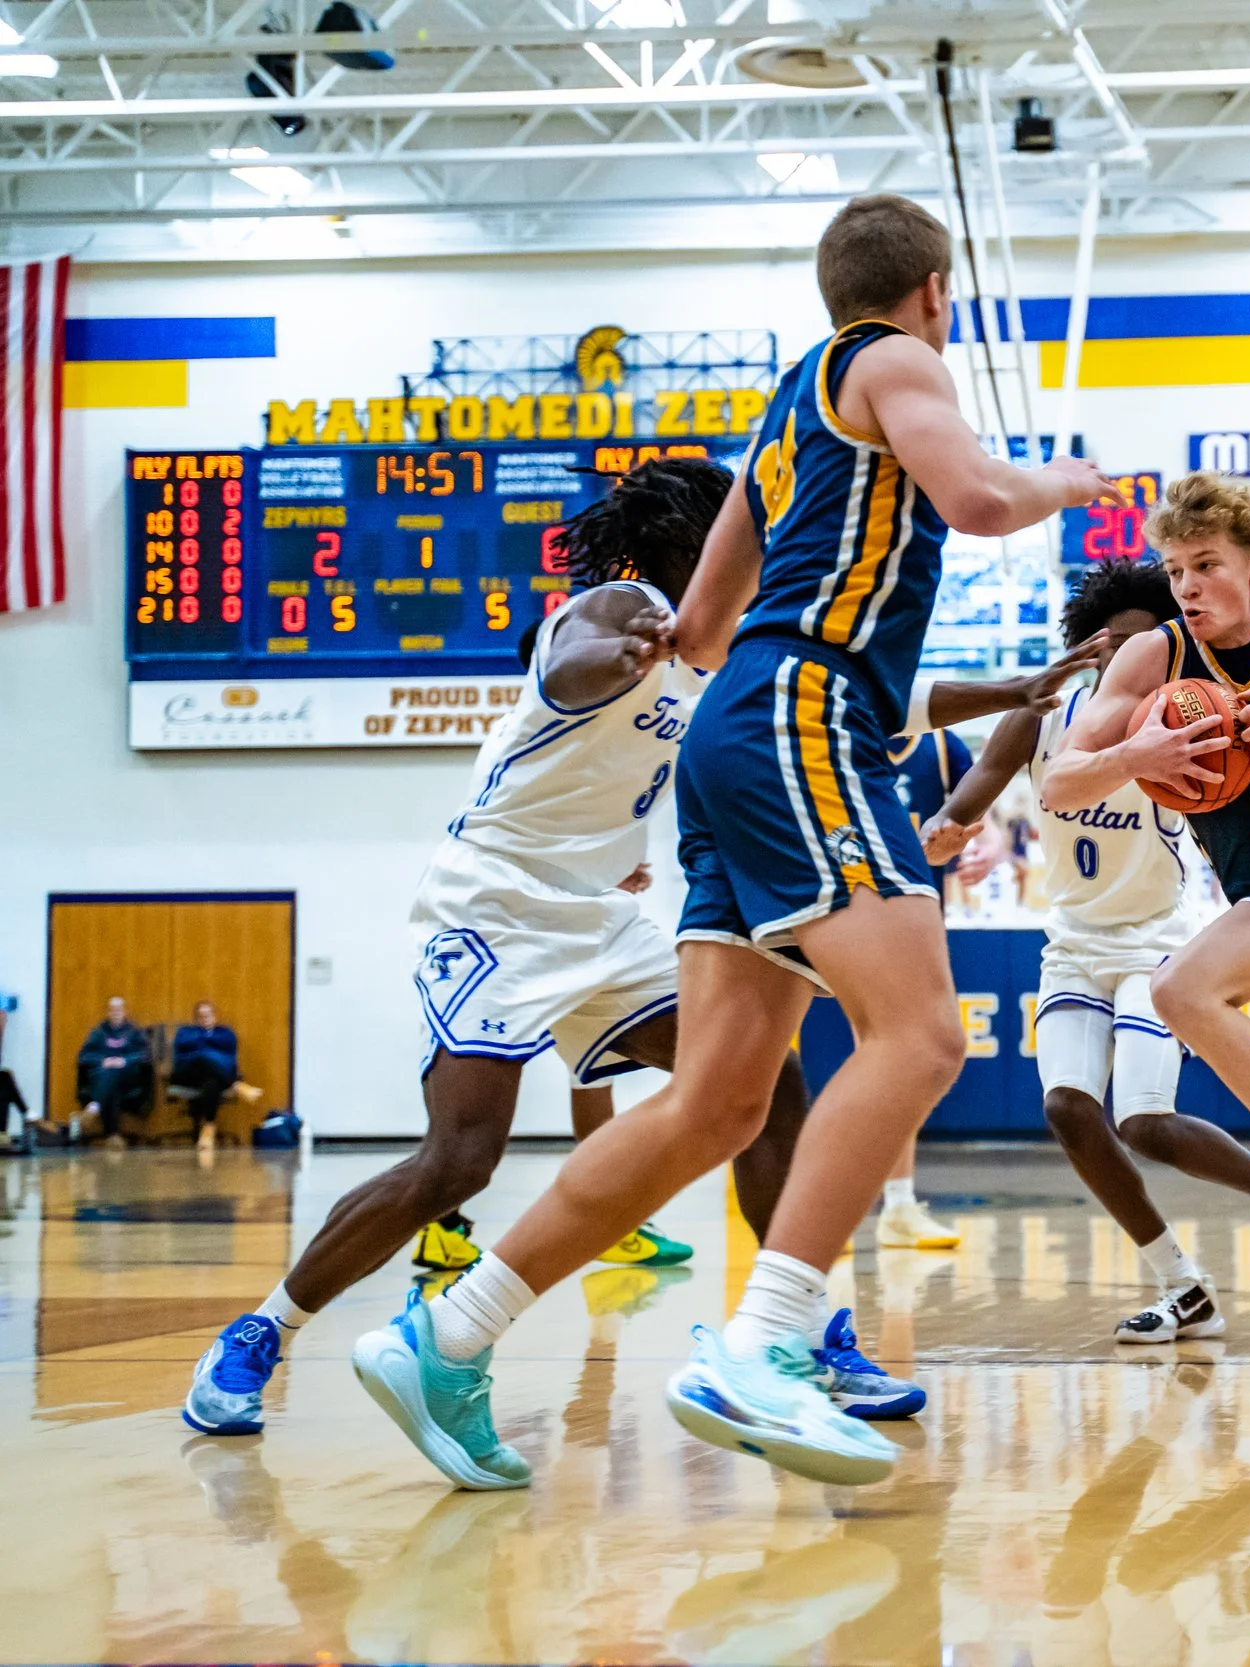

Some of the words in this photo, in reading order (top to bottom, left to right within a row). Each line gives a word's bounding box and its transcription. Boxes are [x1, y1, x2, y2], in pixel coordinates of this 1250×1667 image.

[267, 392, 634, 445] MAHTOMEDI
[655, 389, 773, 436] ZEP
[376, 451, 483, 497] 14:57
[180, 480, 199, 507] 0
[222, 480, 242, 506] 0
[146, 509, 174, 536] 10
[180, 509, 199, 536] 0
[222, 508, 242, 535] 2
[1083, 506, 1145, 559] 20
[146, 540, 174, 563] 14
[180, 538, 199, 565] 0
[222, 537, 242, 564] 0
[313, 531, 341, 577] 2
[420, 536, 433, 569] 1
[146, 568, 174, 594] 15
[180, 566, 199, 594] 0
[222, 566, 242, 593] 0
[179, 596, 199, 623] 0
[222, 595, 242, 622] 0
[282, 595, 306, 632] 0
[331, 595, 356, 632] 5
[485, 592, 510, 630] 5
[389, 686, 480, 709] PROUD
[487, 684, 525, 707] SU
[364, 714, 398, 737] OF
[1073, 835, 1100, 881] 0
